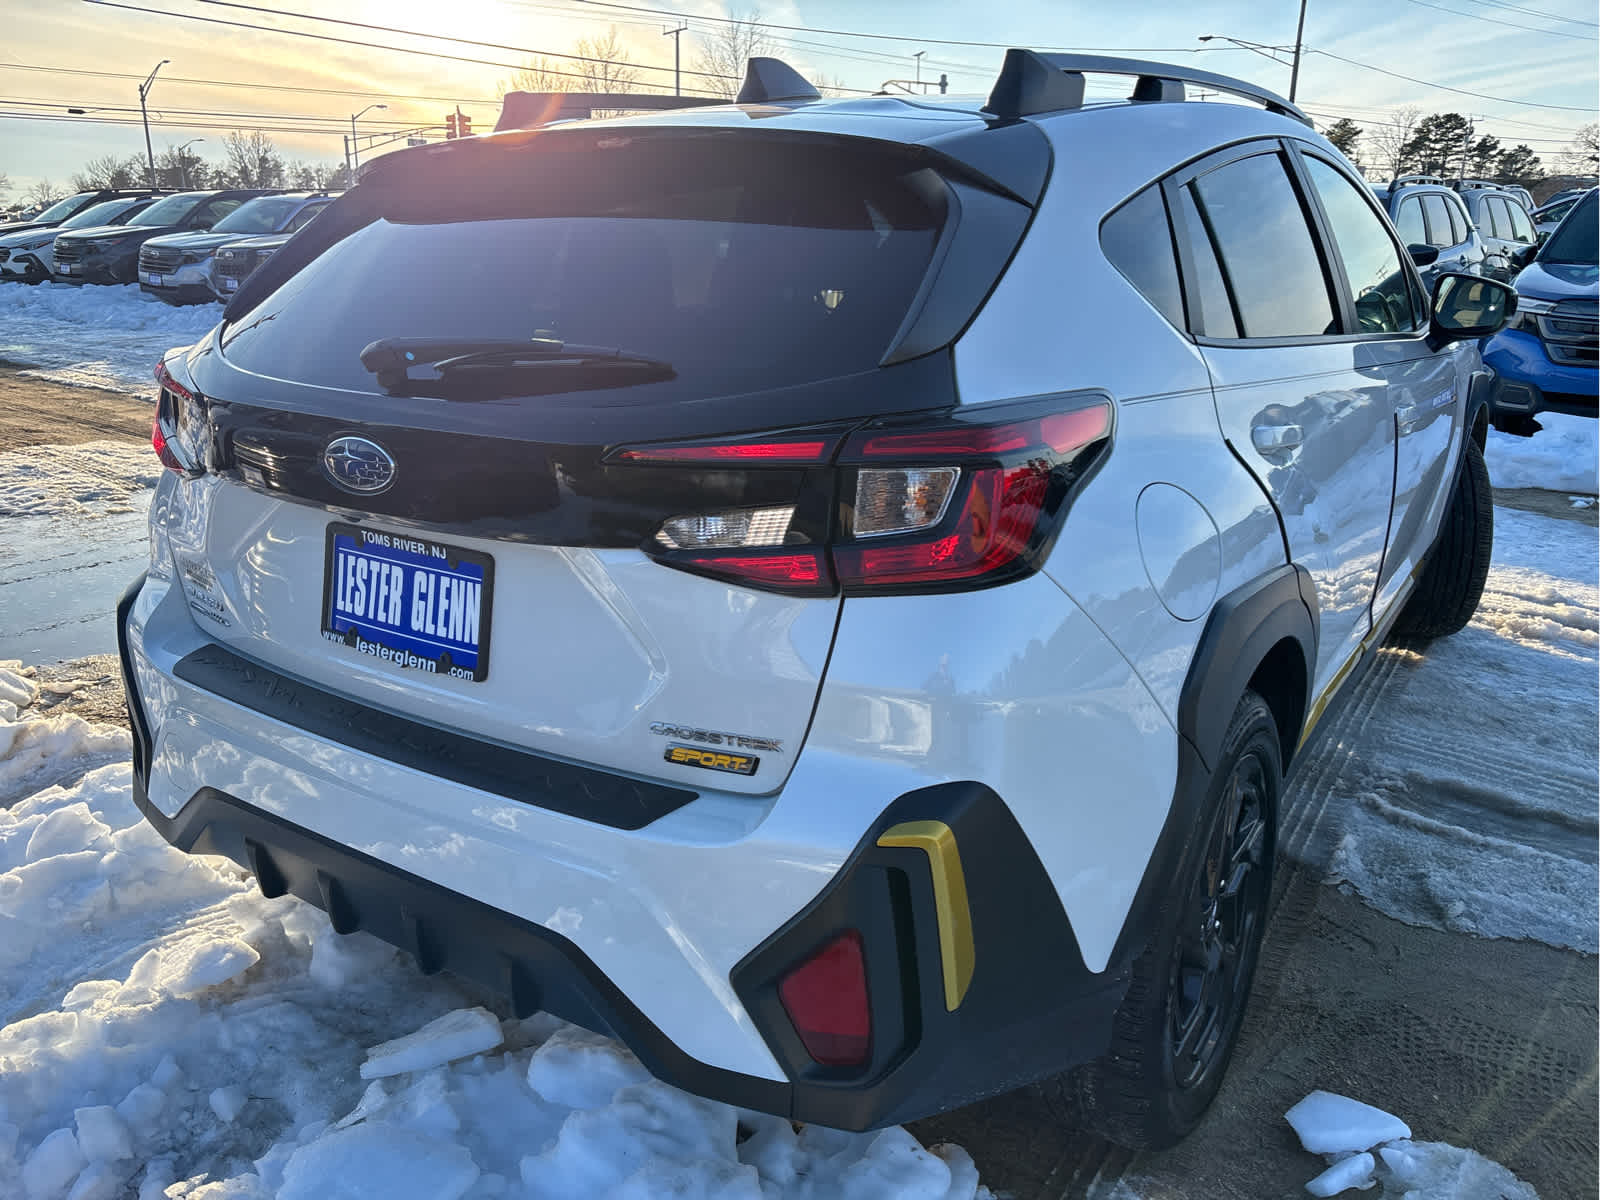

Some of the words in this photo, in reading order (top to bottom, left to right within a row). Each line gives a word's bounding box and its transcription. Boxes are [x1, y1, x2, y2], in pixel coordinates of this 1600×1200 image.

[361, 530, 390, 548] TOMS
[431, 545, 447, 560] NJ
[336, 553, 403, 626] LESTER
[411, 570, 482, 646] GLENN
[321, 631, 346, 645] www.
[356, 636, 437, 673] lesterglenn
[447, 666, 474, 681] .com
[649, 720, 784, 753] CROSSTREK
[671, 747, 748, 770] SPORT
